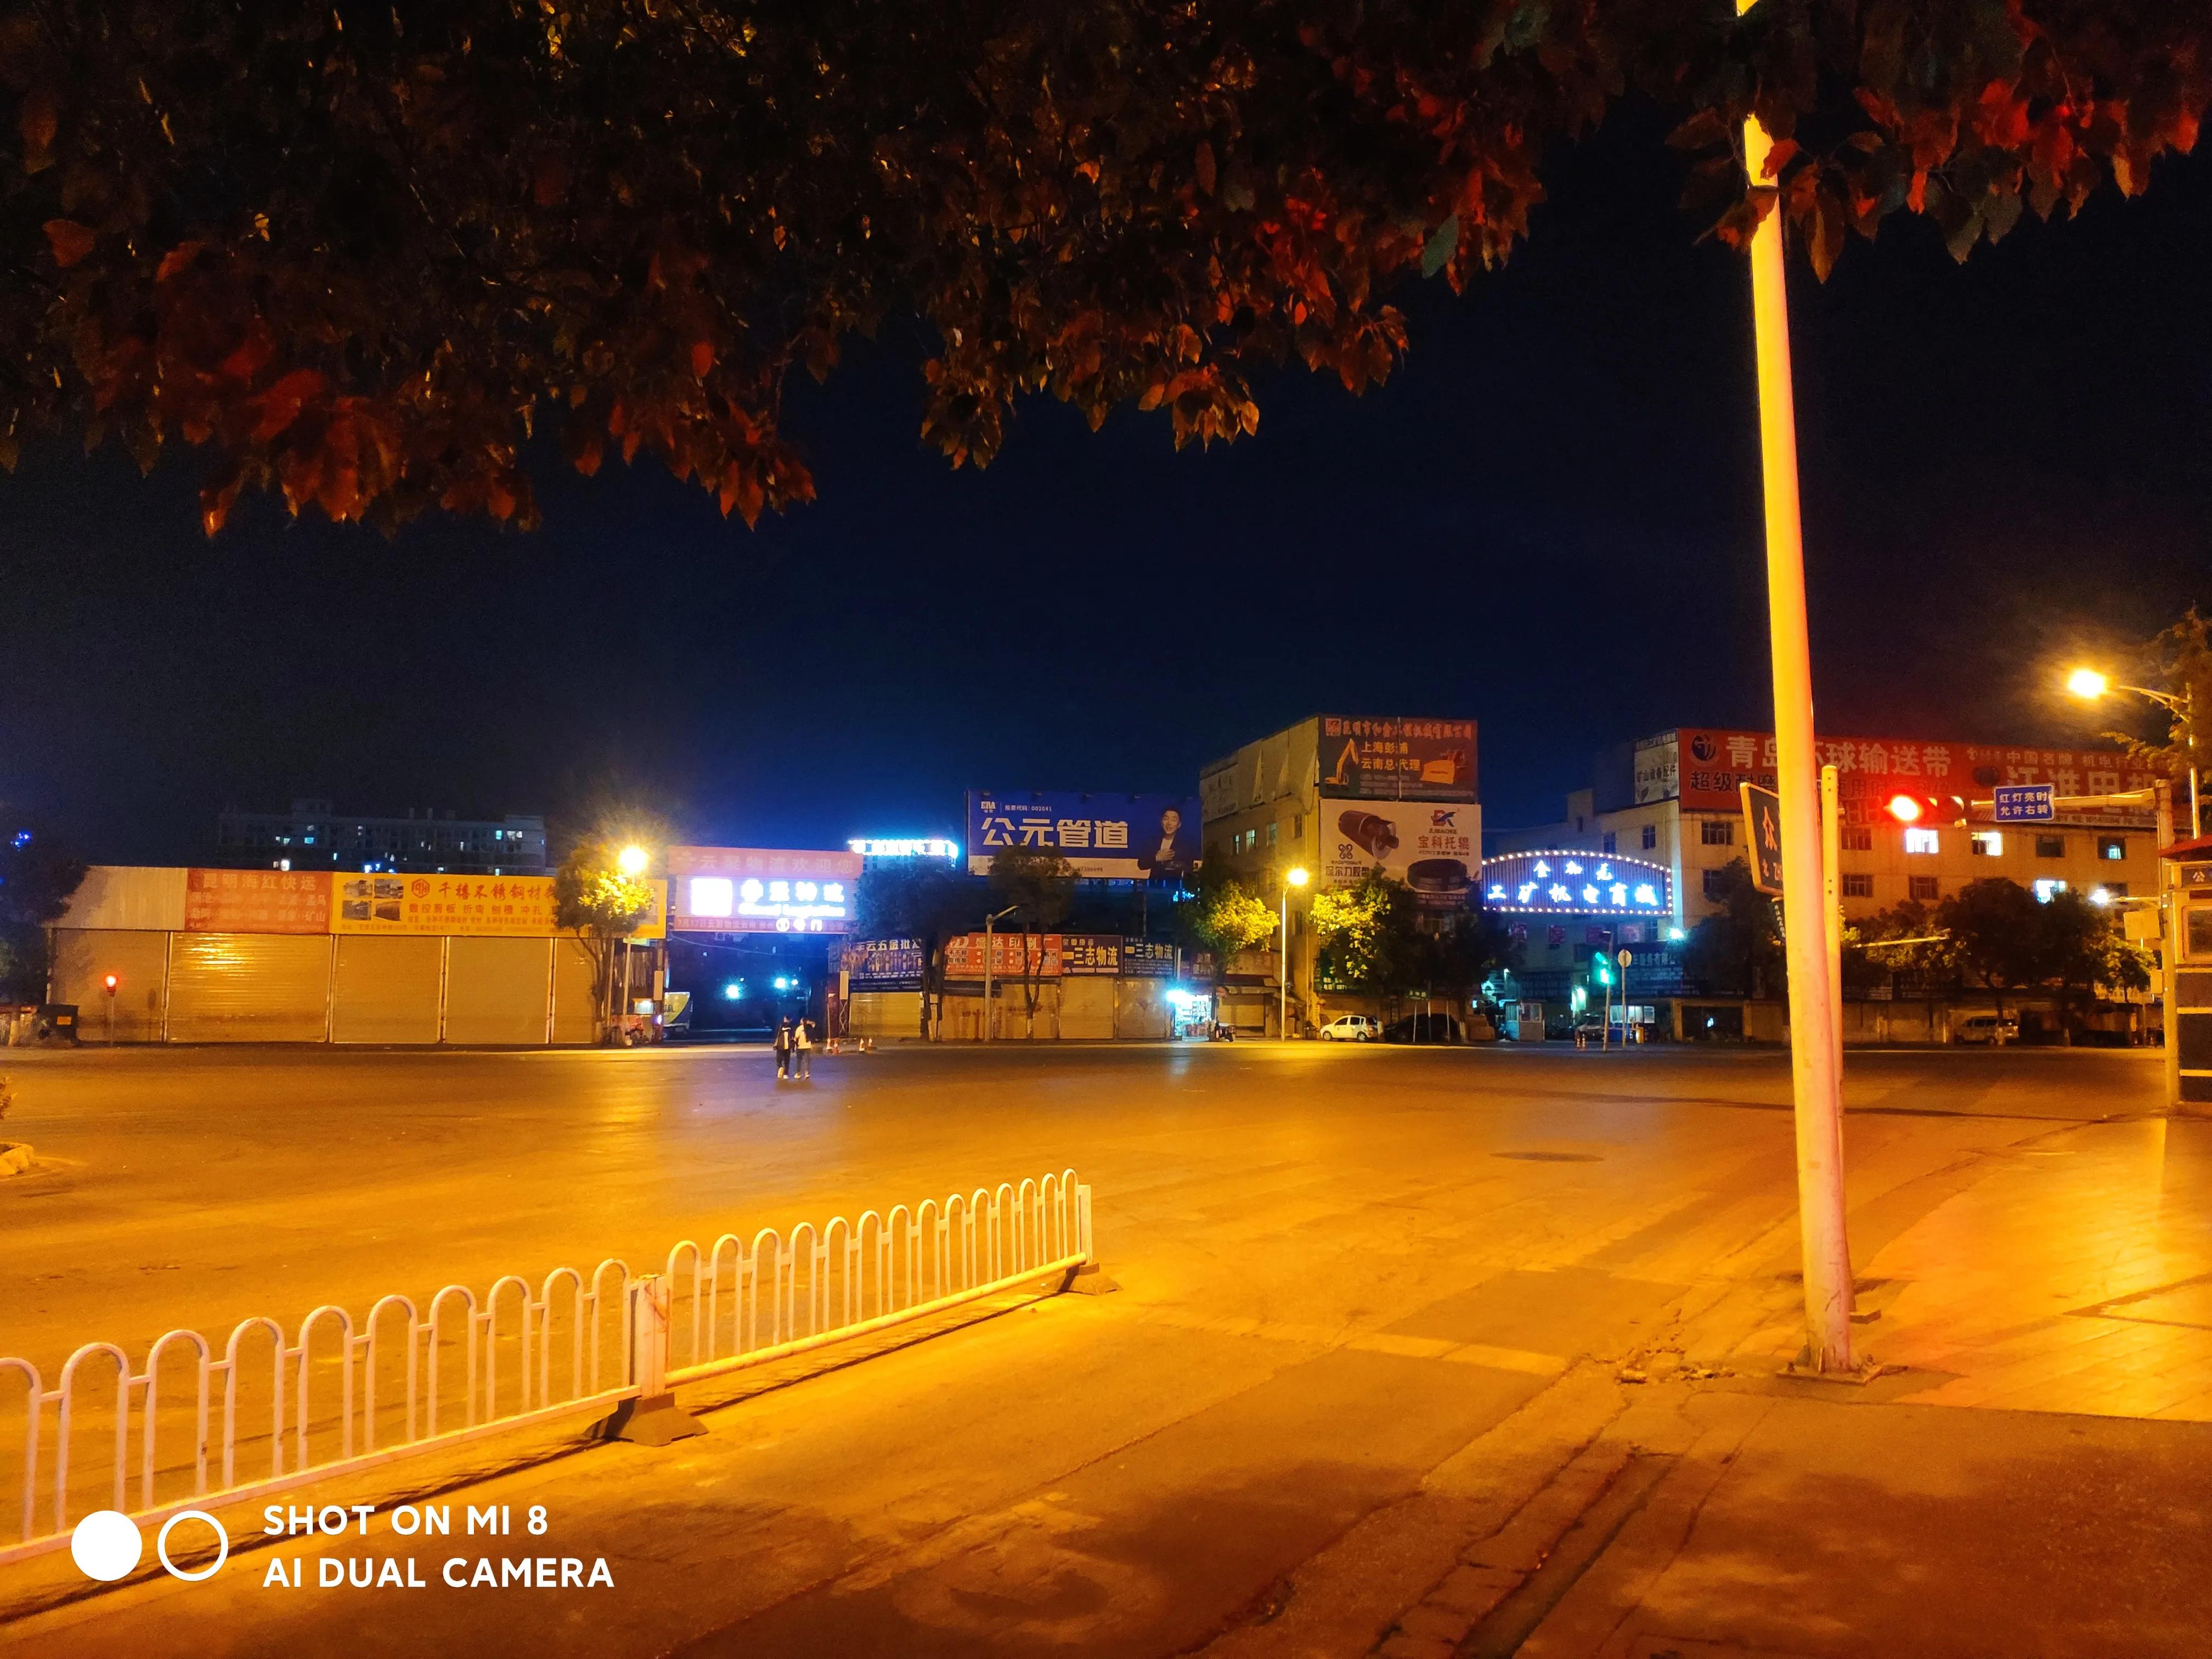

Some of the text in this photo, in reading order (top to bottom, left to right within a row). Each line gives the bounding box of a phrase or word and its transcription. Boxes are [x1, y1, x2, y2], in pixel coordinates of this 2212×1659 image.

[1726, 735, 1951, 777] 青岛球输送带
[1361, 757, 1421, 771] 云南总代理
[1999, 791, 2048, 803] 红灯亮时
[2000, 805, 2049, 816] 允许右转
[981, 817, 1128, 848] 公元管道
[1418, 836, 1470, 850] 宝科托辊
[1074, 946, 1118, 966] 三志物流
[1135, 943, 1173, 959] 三志物流
